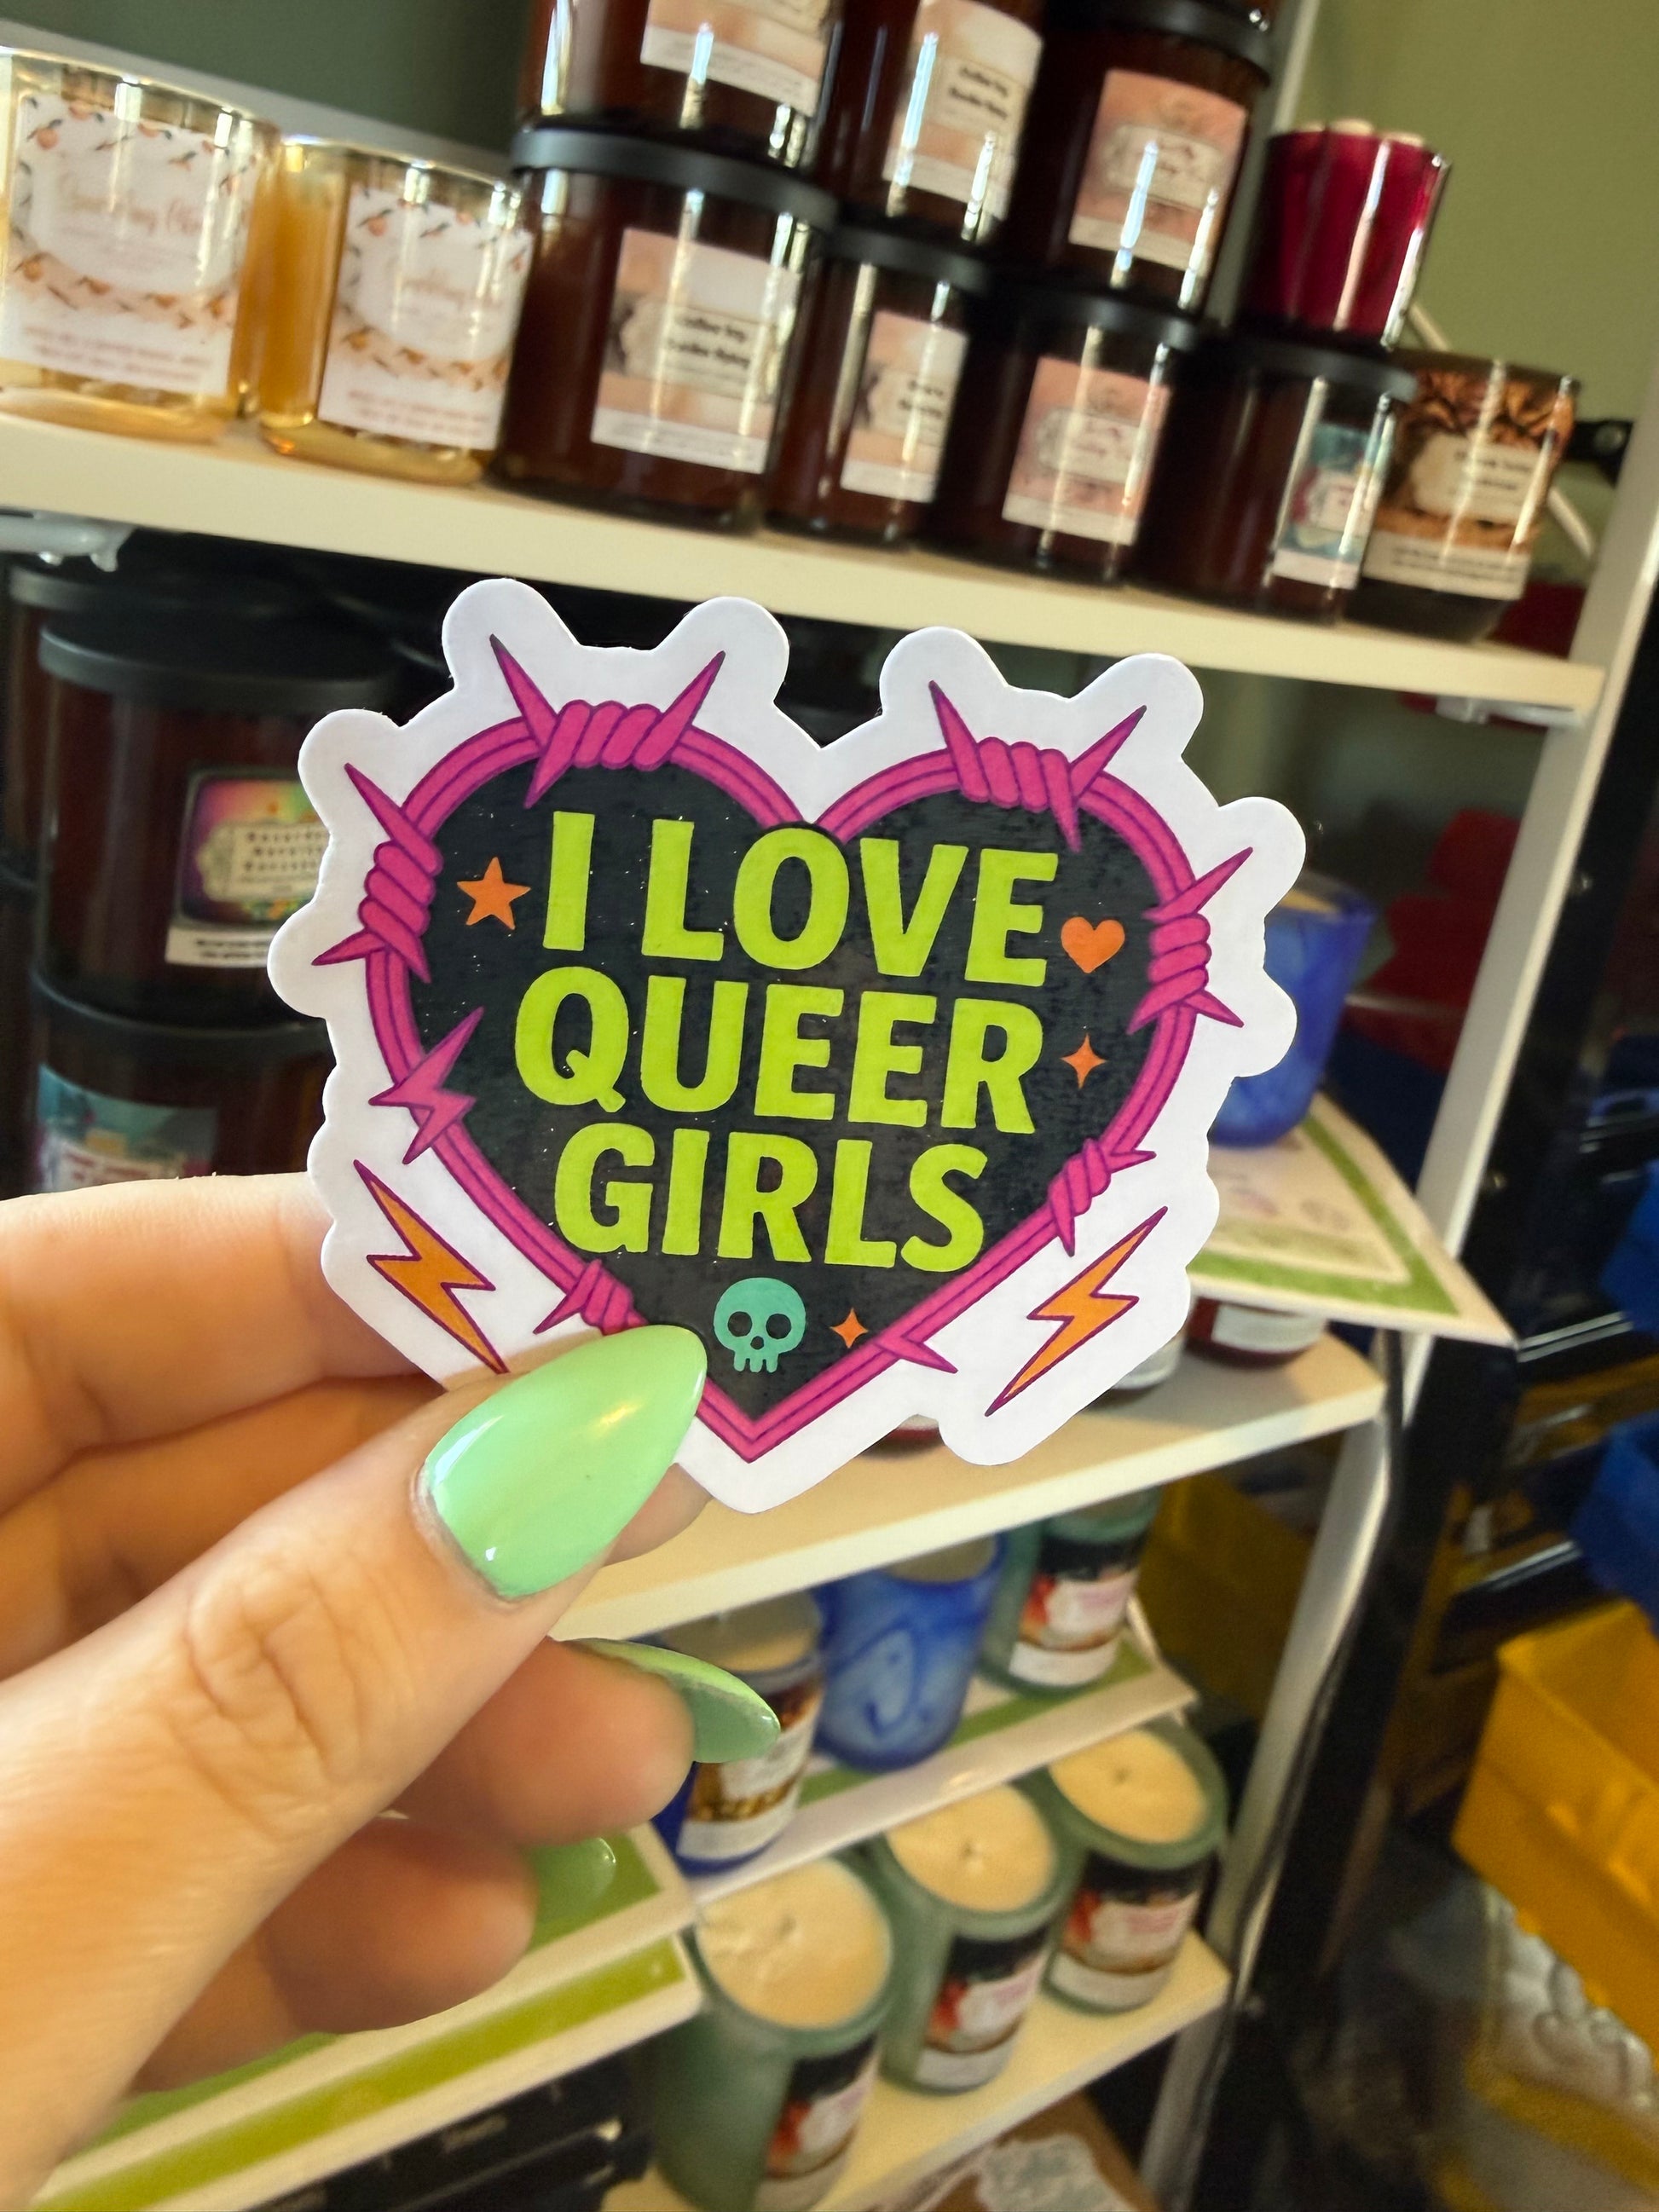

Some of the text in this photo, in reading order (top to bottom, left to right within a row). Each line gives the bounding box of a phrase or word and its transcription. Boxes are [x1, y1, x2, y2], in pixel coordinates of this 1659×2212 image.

[543, 811, 1059, 986] I LOVE
[514, 966, 1043, 1134] QUEER
[554, 1122, 988, 1271] GIRLS
